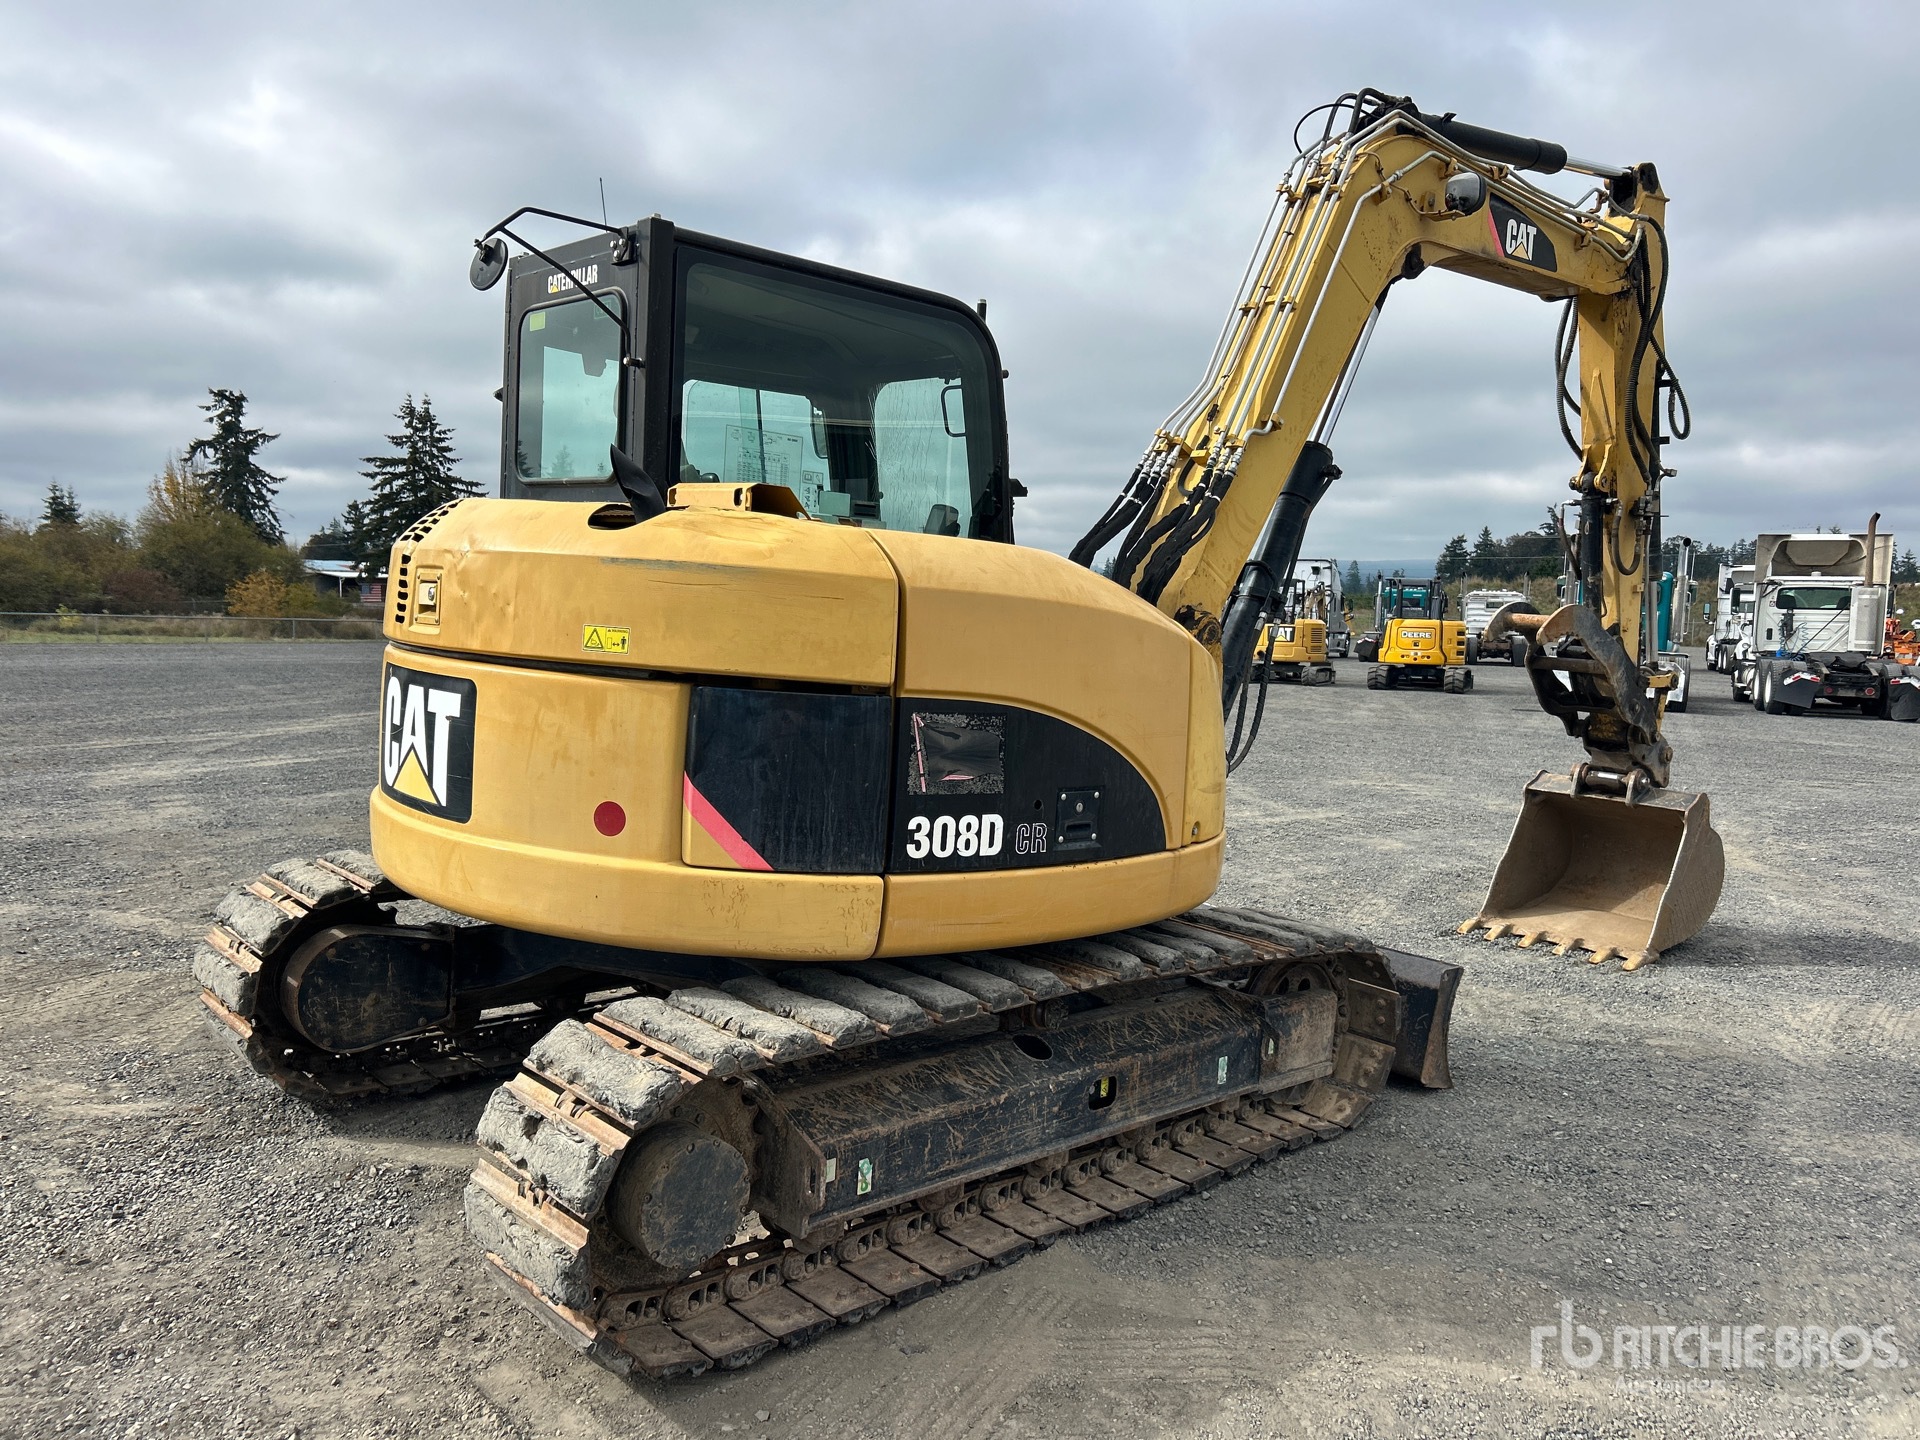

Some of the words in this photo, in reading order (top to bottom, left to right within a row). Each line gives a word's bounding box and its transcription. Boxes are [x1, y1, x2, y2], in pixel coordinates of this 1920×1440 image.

[1506, 218, 1537, 261] CAT
[547, 264, 598, 294] CATERPILLAR
[1269, 627, 1292, 641] AT
[1401, 630, 1432, 639] DEERE
[384, 676, 462, 807] CAT
[906, 813, 1004, 859] 308D
[1015, 822, 1048, 855] CR
